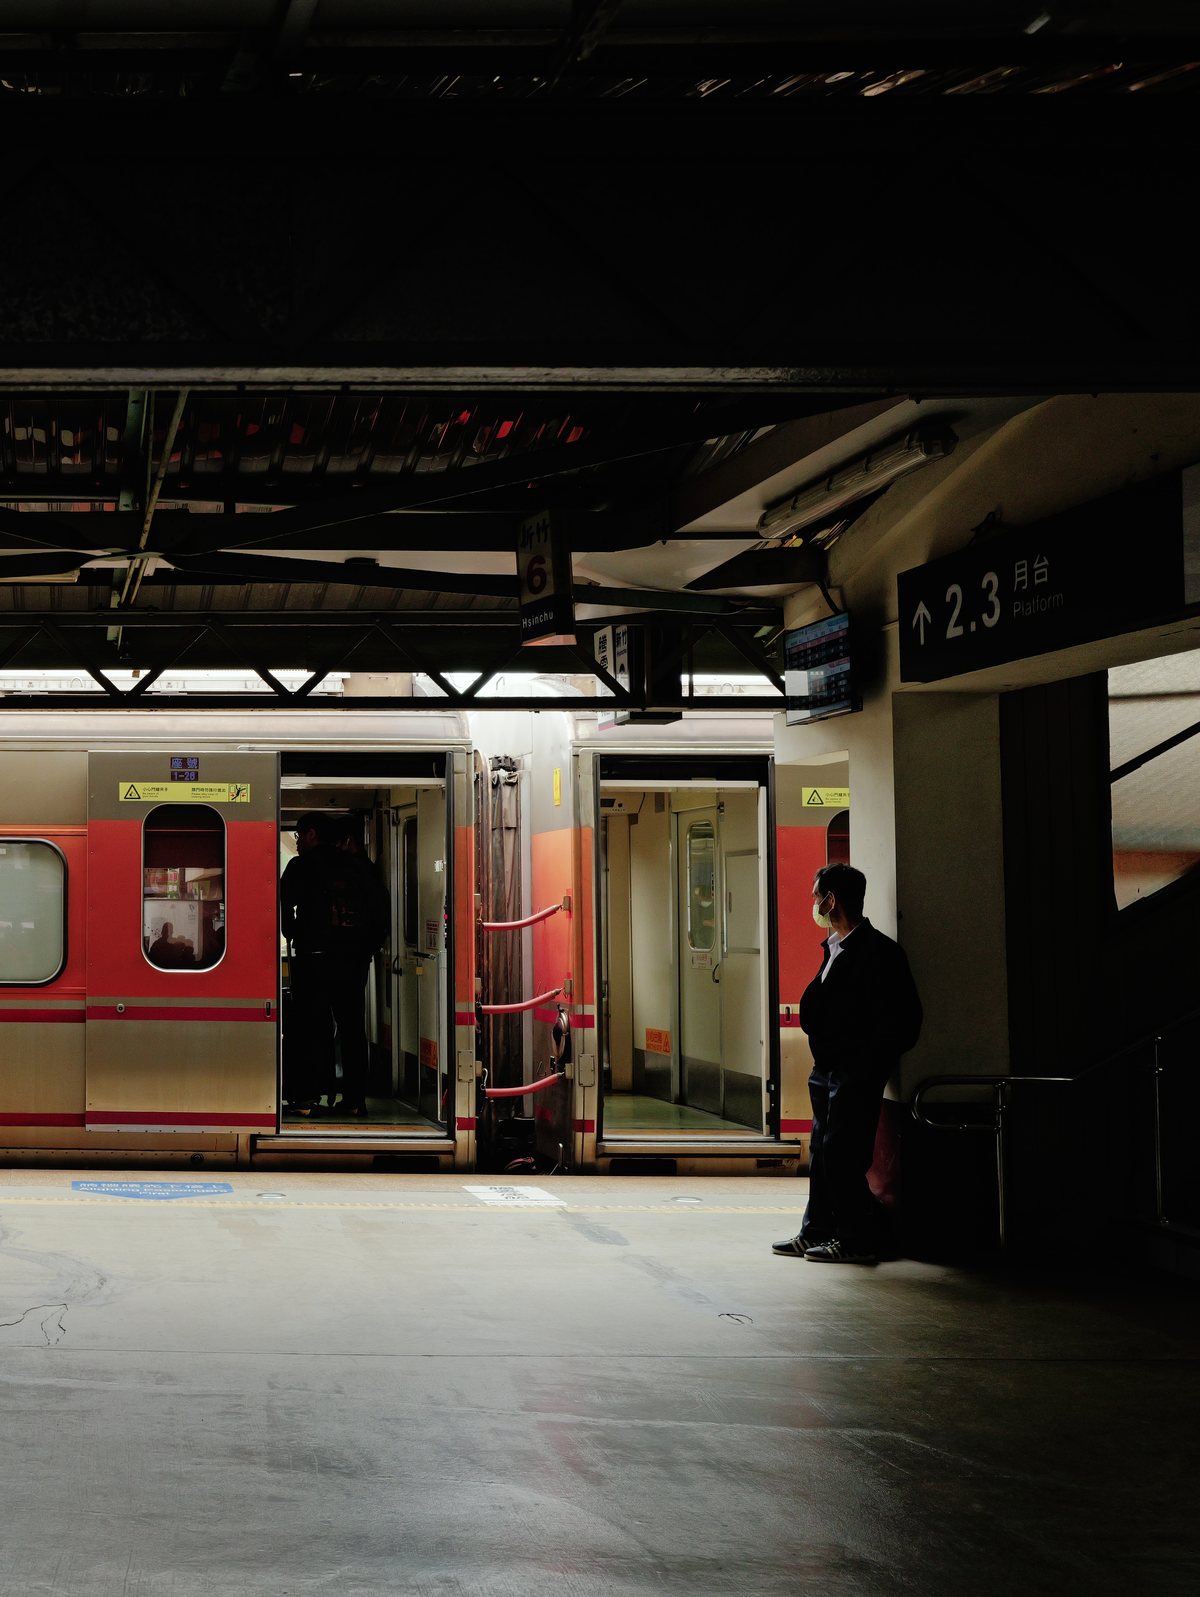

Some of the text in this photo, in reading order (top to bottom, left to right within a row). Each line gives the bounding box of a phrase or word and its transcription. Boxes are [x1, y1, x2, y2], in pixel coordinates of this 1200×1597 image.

[520, 518, 551, 549] 新竹
[526, 554, 547, 595] 6
[1014, 553, 1049, 592] 月台
[521, 609, 554, 630] Hsinchu
[1013, 592, 1064, 619] Platform
